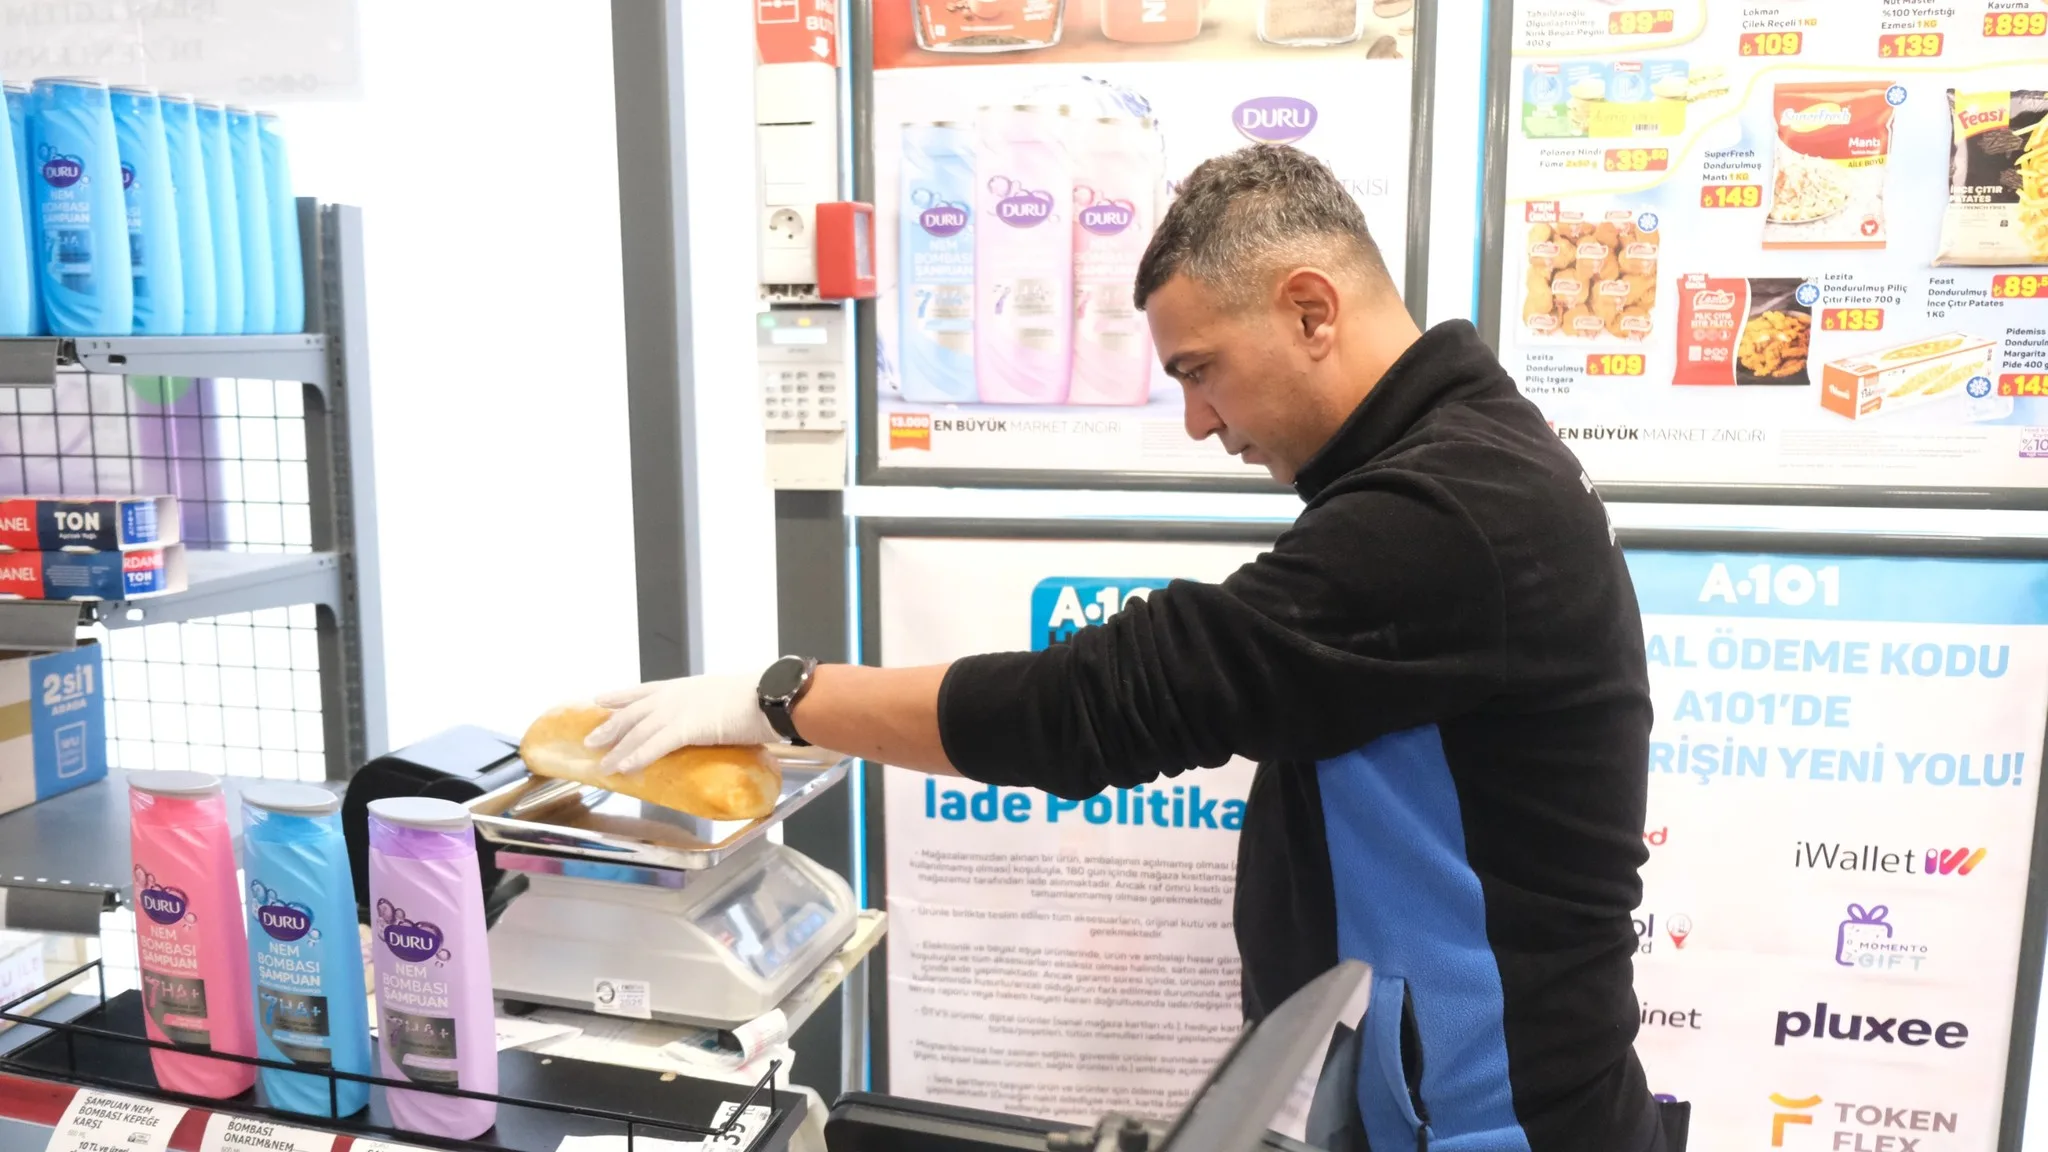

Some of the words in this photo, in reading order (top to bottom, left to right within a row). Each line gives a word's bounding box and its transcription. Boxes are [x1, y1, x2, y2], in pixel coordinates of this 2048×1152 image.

[1743, 8, 1779, 16] Lokman
[1882, 8, 1910, 17] %100
[1742, 20, 1765, 29] Çilek
[1767, 19, 1796, 28] Reçeli
[1881, 21, 1916, 29] Ezmesi
[1242, 108, 1310, 129] DURU
[1704, 150, 1755, 159] SuperFresh
[46, 166, 79, 178] DURU
[1703, 161, 1761, 170] Dondurulmuş
[1703, 173, 1728, 181] Mantı
[1002, 203, 1046, 217] DURU
[925, 213, 964, 227] DURU
[1085, 212, 1128, 226] DURU
[1825, 273, 1853, 281] Lezita
[1929, 277, 1954, 285] Feast
[1824, 283, 1885, 293] Dondurulmuş
[1887, 283, 1907, 293] Piliç
[1928, 288, 1988, 297] Dondurulmuş
[1823, 296, 1842, 304] Çıtır
[1844, 295, 1872, 303] Fileto
[1875, 295, 1893, 303] 700
[1927, 299, 1946, 307] İnce
[1948, 300, 1967, 309] Çıtır
[2003, 350, 2046, 359] Margarita
[1527, 364, 1584, 373] Dondurulmuş
[1526, 376, 1545, 384] Piliç
[1558, 386, 1570, 394] KG
[934, 420, 955, 431] EN
[957, 418, 1007, 432] BÜYÜK
[1010, 421, 1067, 433] MARKET
[1558, 427, 1579, 439] EN
[1582, 425, 1638, 440] BÜYÜK
[1643, 428, 1704, 441] MARKET
[54, 512, 100, 531] TON
[127, 571, 152, 583] TON
[1708, 627, 1870, 675] ÖDEME
[1880, 642, 2010, 678] KODU
[1777, 741, 1884, 783] YENİ
[1896, 751, 2025, 787] YOLU!
[1041, 853, 1053, 862] bir
[1795, 841, 1917, 875] iWallet
[1066, 866, 1084, 875] 180
[1087, 868, 1106, 878] gün
[143, 895, 180, 915] DURU
[263, 911, 305, 931] DURU
[150, 925, 177, 941] NEM
[140, 935, 197, 958] BOMBASI
[389, 931, 434, 951] DURU
[1860, 941, 1928, 953] MOMENTO
[269, 941, 300, 958] NEM
[257, 951, 320, 974] BOMBASI
[395, 963, 427, 978] NEM
[382, 972, 448, 996] BOMBASI
[1774, 1001, 1969, 1049] pluxee
[130, 1103, 154, 1114] NEM
[72, 1117, 102, 1130] KARŞI
[79, 1106, 122, 1121] BOMBASI
[122, 1113, 160, 1128] KEPEĞE
[1833, 1102, 1958, 1134] TOKEN
[227, 1121, 274, 1137] BOMBASI
[79, 1140, 88, 1150] 10
[88, 1142, 98, 1151] TL
[224, 1132, 295, 1151] ONARIM&NEM
